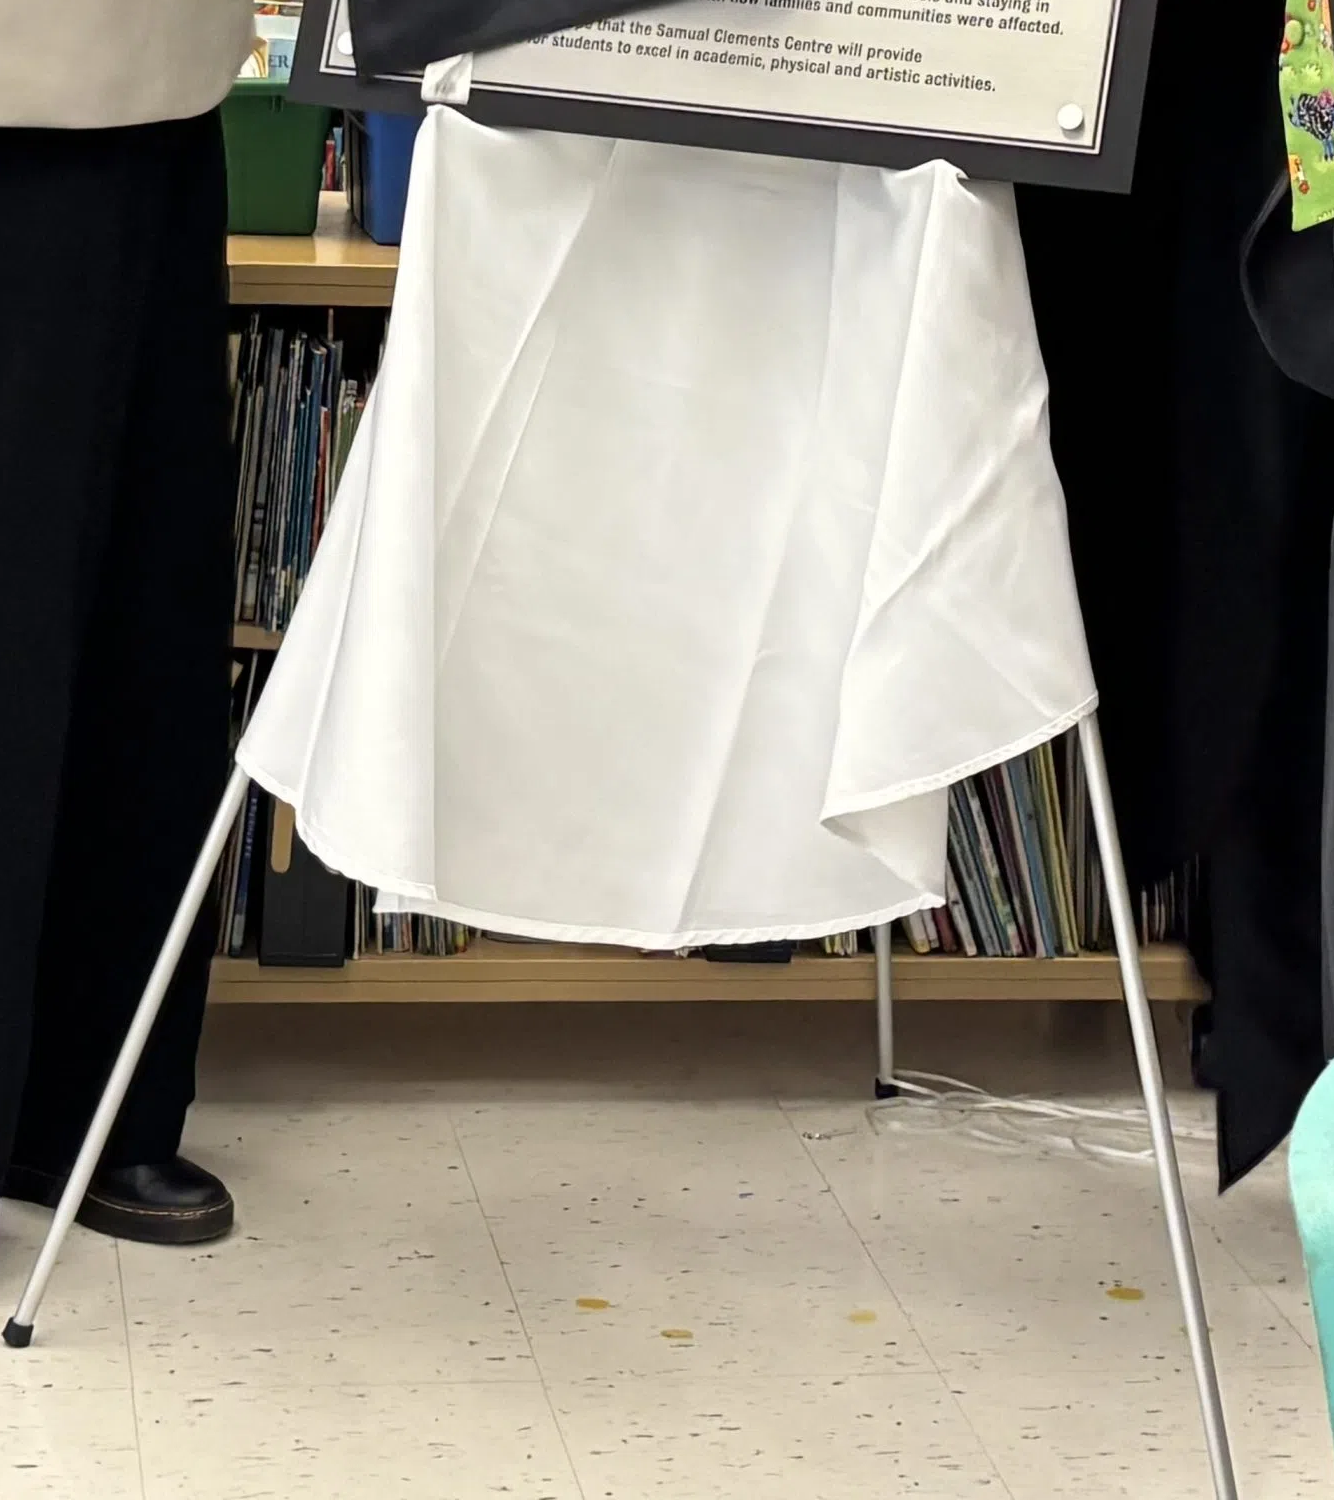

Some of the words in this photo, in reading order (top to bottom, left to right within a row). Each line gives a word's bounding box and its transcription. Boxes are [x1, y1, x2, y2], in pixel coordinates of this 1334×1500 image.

[825, 0, 853, 15] and
[857, 2, 952, 25] communities
[957, 14, 994, 28] were
[998, 16, 1064, 36] affected.
[597, 19, 625, 33] that
[630, 21, 652, 36] the
[656, 23, 710, 41] Samual
[714, 28, 780, 49] Clements
[784, 35, 832, 55] Centre
[837, 41, 863, 57] will
[867, 45, 923, 63] provide
[552, 35, 613, 53] students
[617, 39, 631, 54] to
[635, 43, 672, 58] excel
[676, 45, 689, 60] in
[693, 48, 766, 70] academic,
[770, 56, 830, 75] physical
[834, 62, 862, 78] and
[866, 66, 920, 84] artistic
[924, 72, 996, 92] activities.
